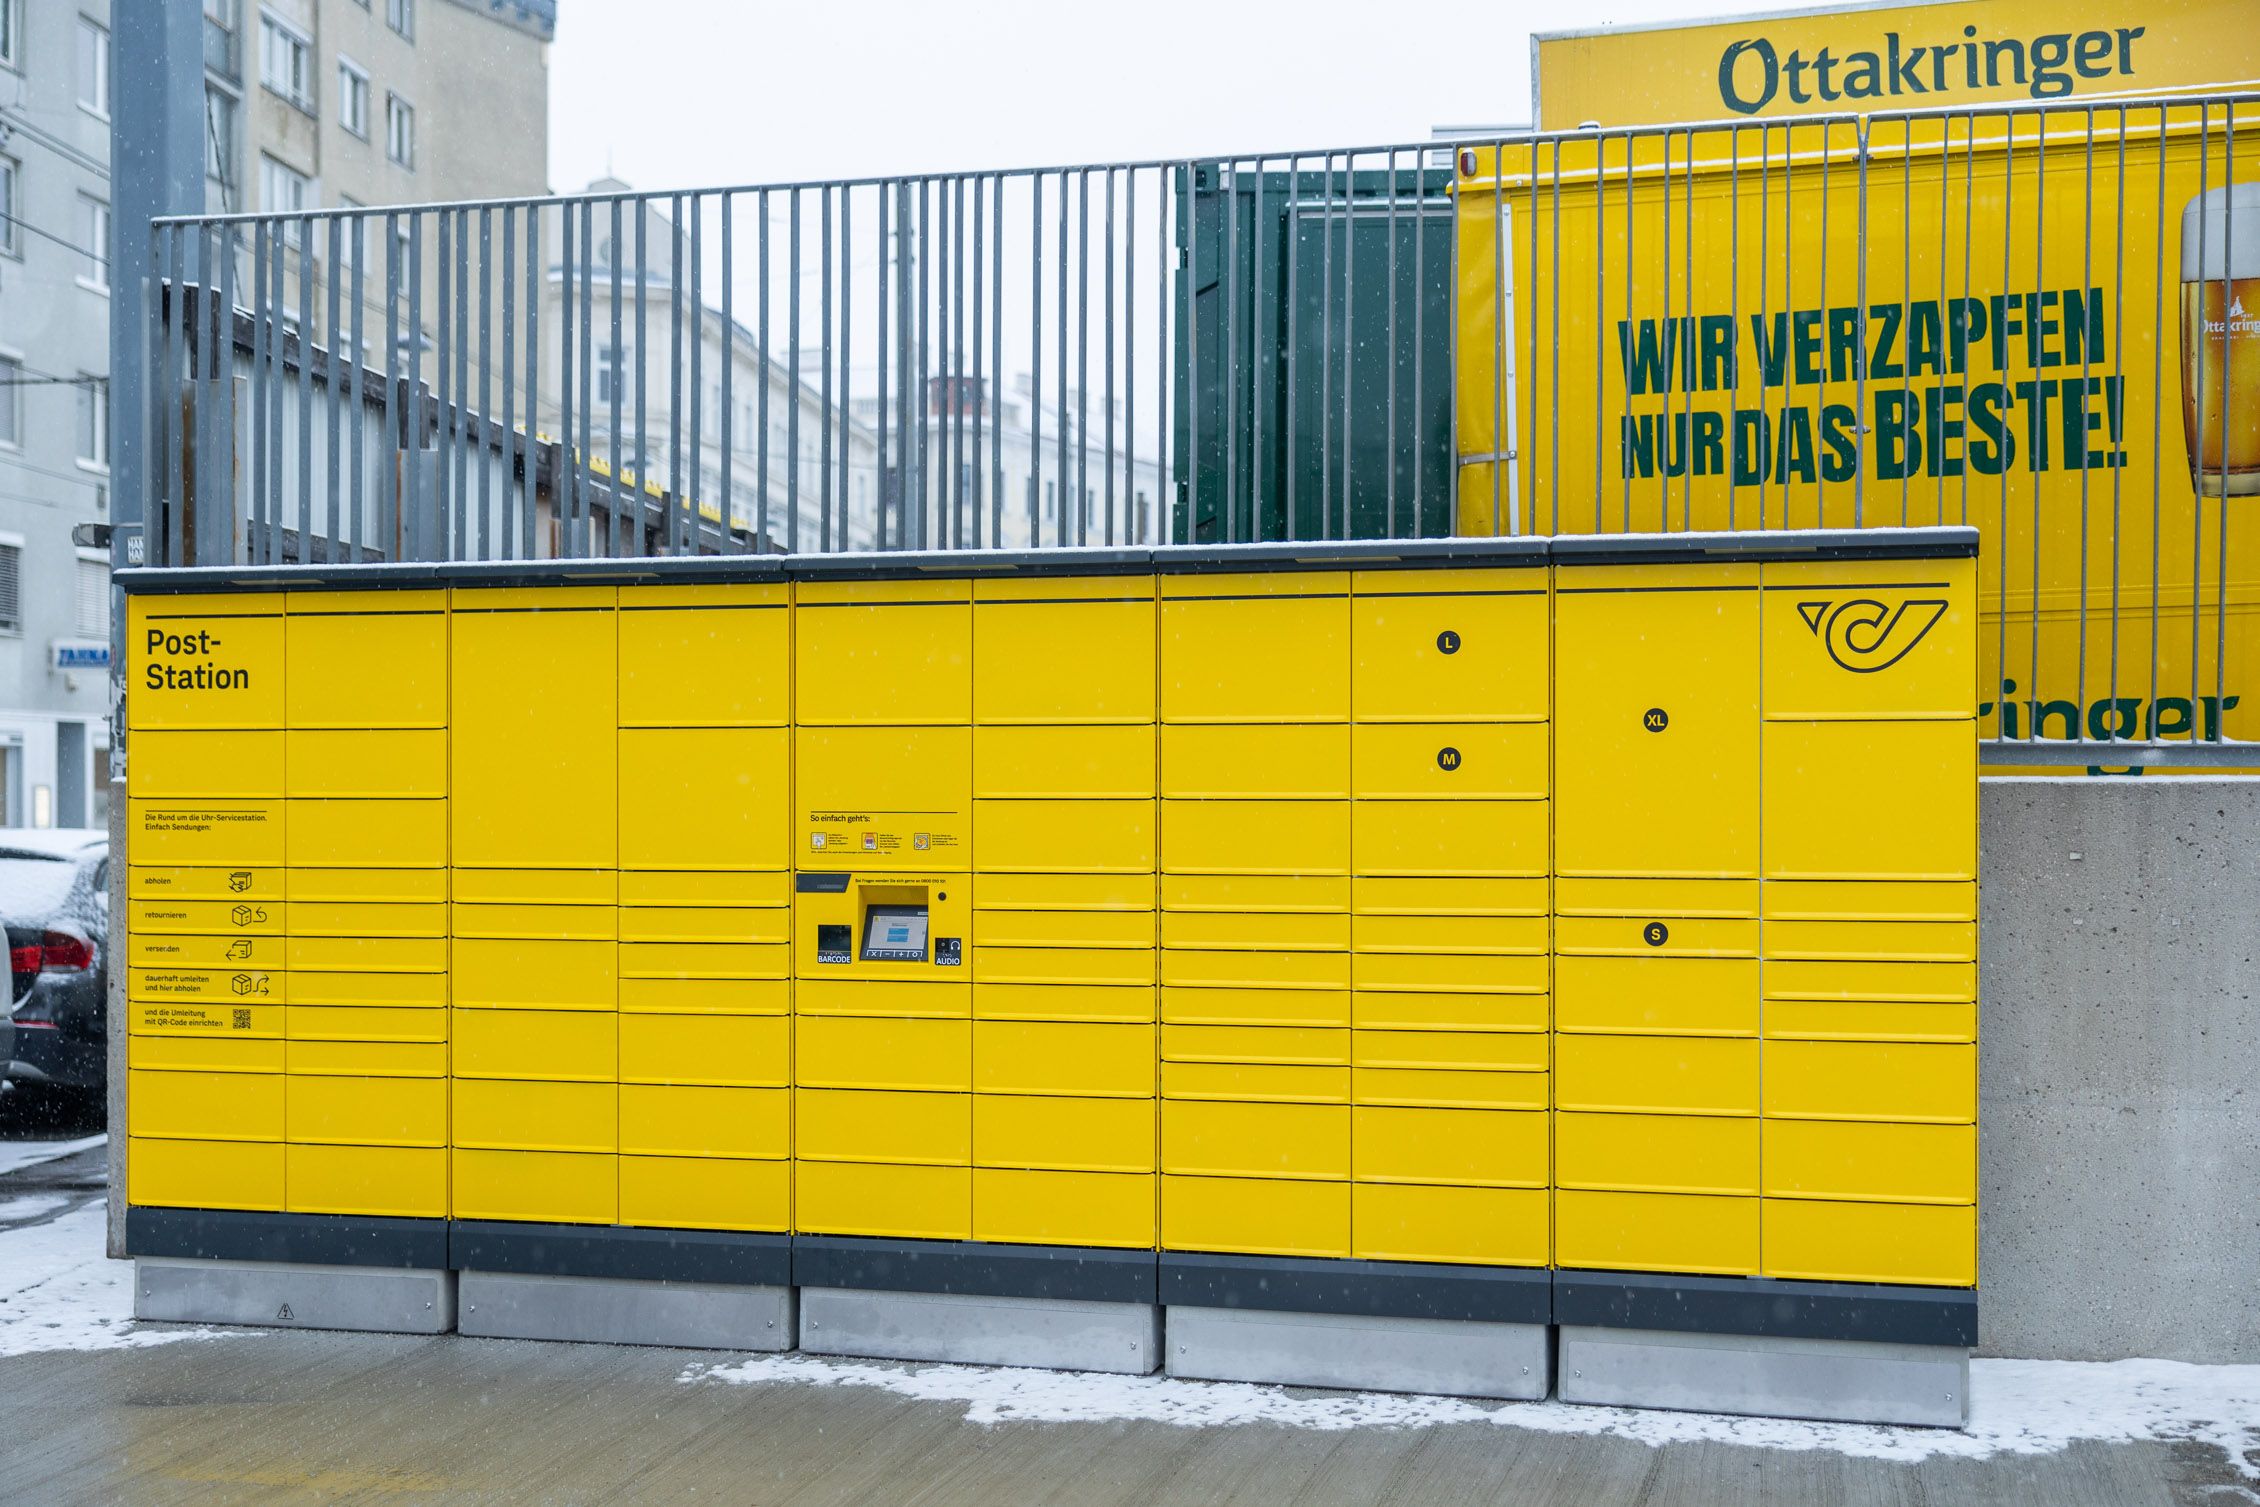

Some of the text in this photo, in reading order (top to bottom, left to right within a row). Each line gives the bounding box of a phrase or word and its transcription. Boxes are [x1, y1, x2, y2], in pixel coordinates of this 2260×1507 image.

[1718, 25, 2145, 115] Ottakringer
[1618, 288, 2106, 395] WIR VERZAPFEN
[1621, 375, 2128, 486] NUR DAS BESTE!
[147, 630, 221, 655] Post-
[1445, 637, 1453, 648] L
[146, 663, 248, 689] Station
[1647, 715, 1665, 726] XL
[1443, 754, 1455, 764] M
[1652, 929, 1660, 940] S
[171, 1010, 206, 1018] Umleitung
